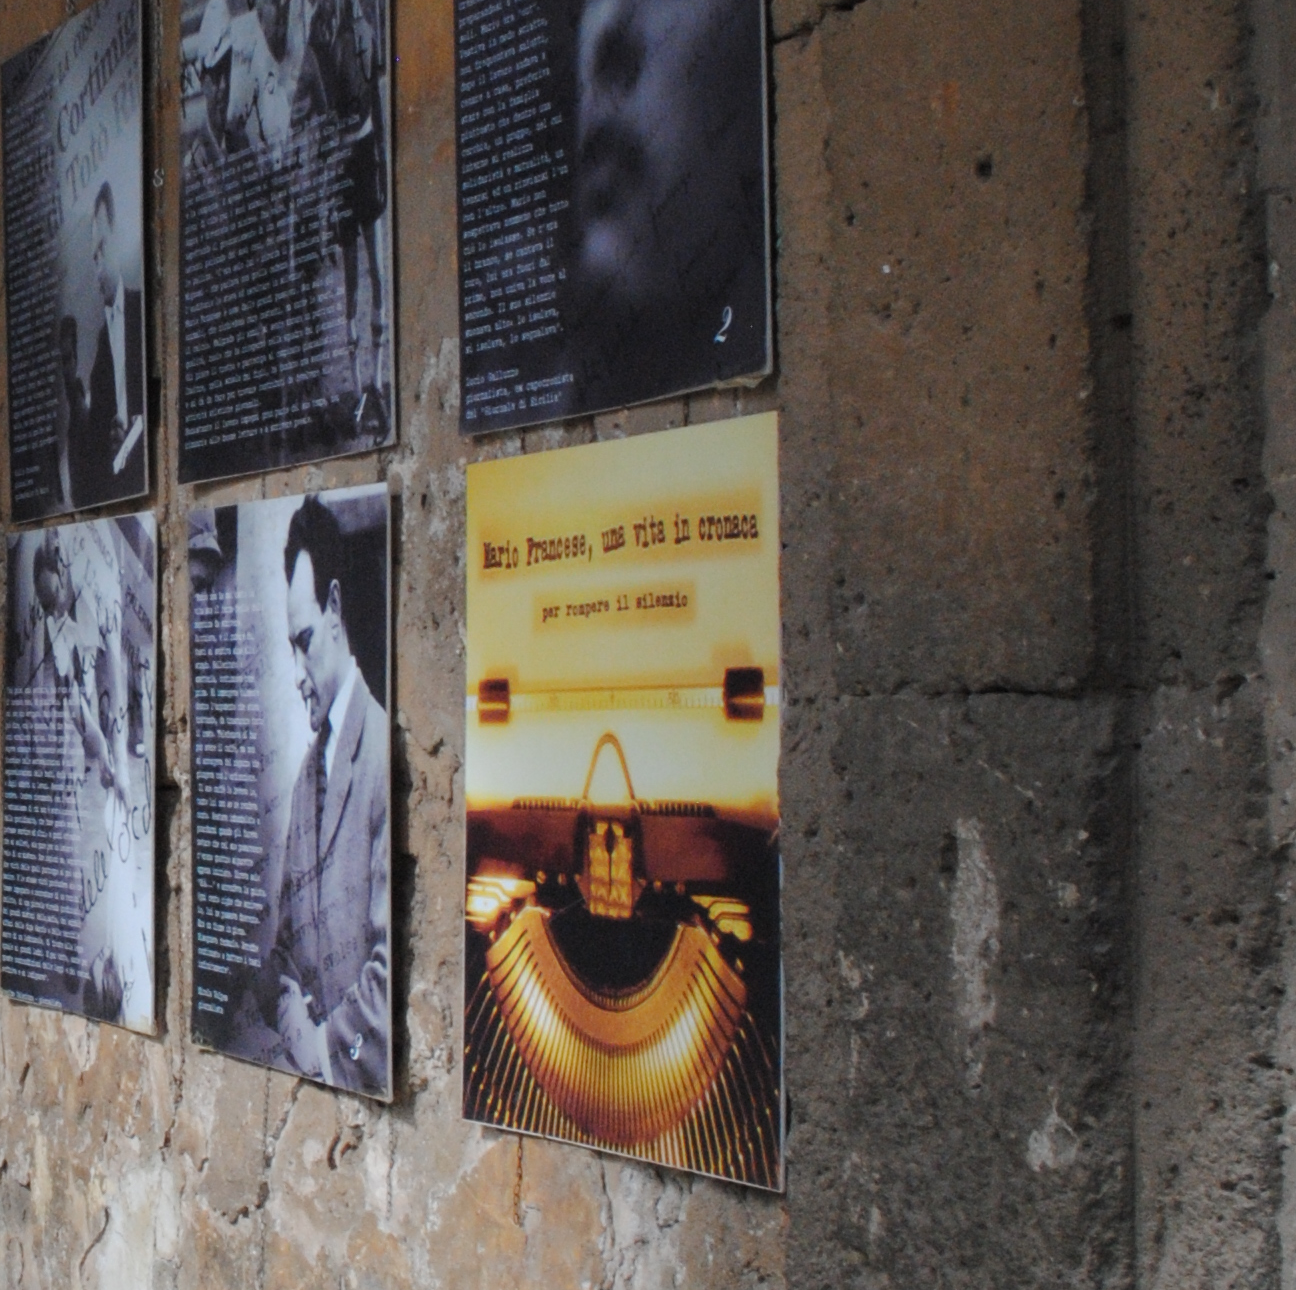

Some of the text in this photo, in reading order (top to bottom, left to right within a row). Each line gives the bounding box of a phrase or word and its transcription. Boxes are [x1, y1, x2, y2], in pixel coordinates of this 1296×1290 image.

[713, 305, 733, 344] 2
[482, 512, 759, 570] Mario Francese, una vita in cronaca
[541, 590, 688, 623] per rompere il silenzio
